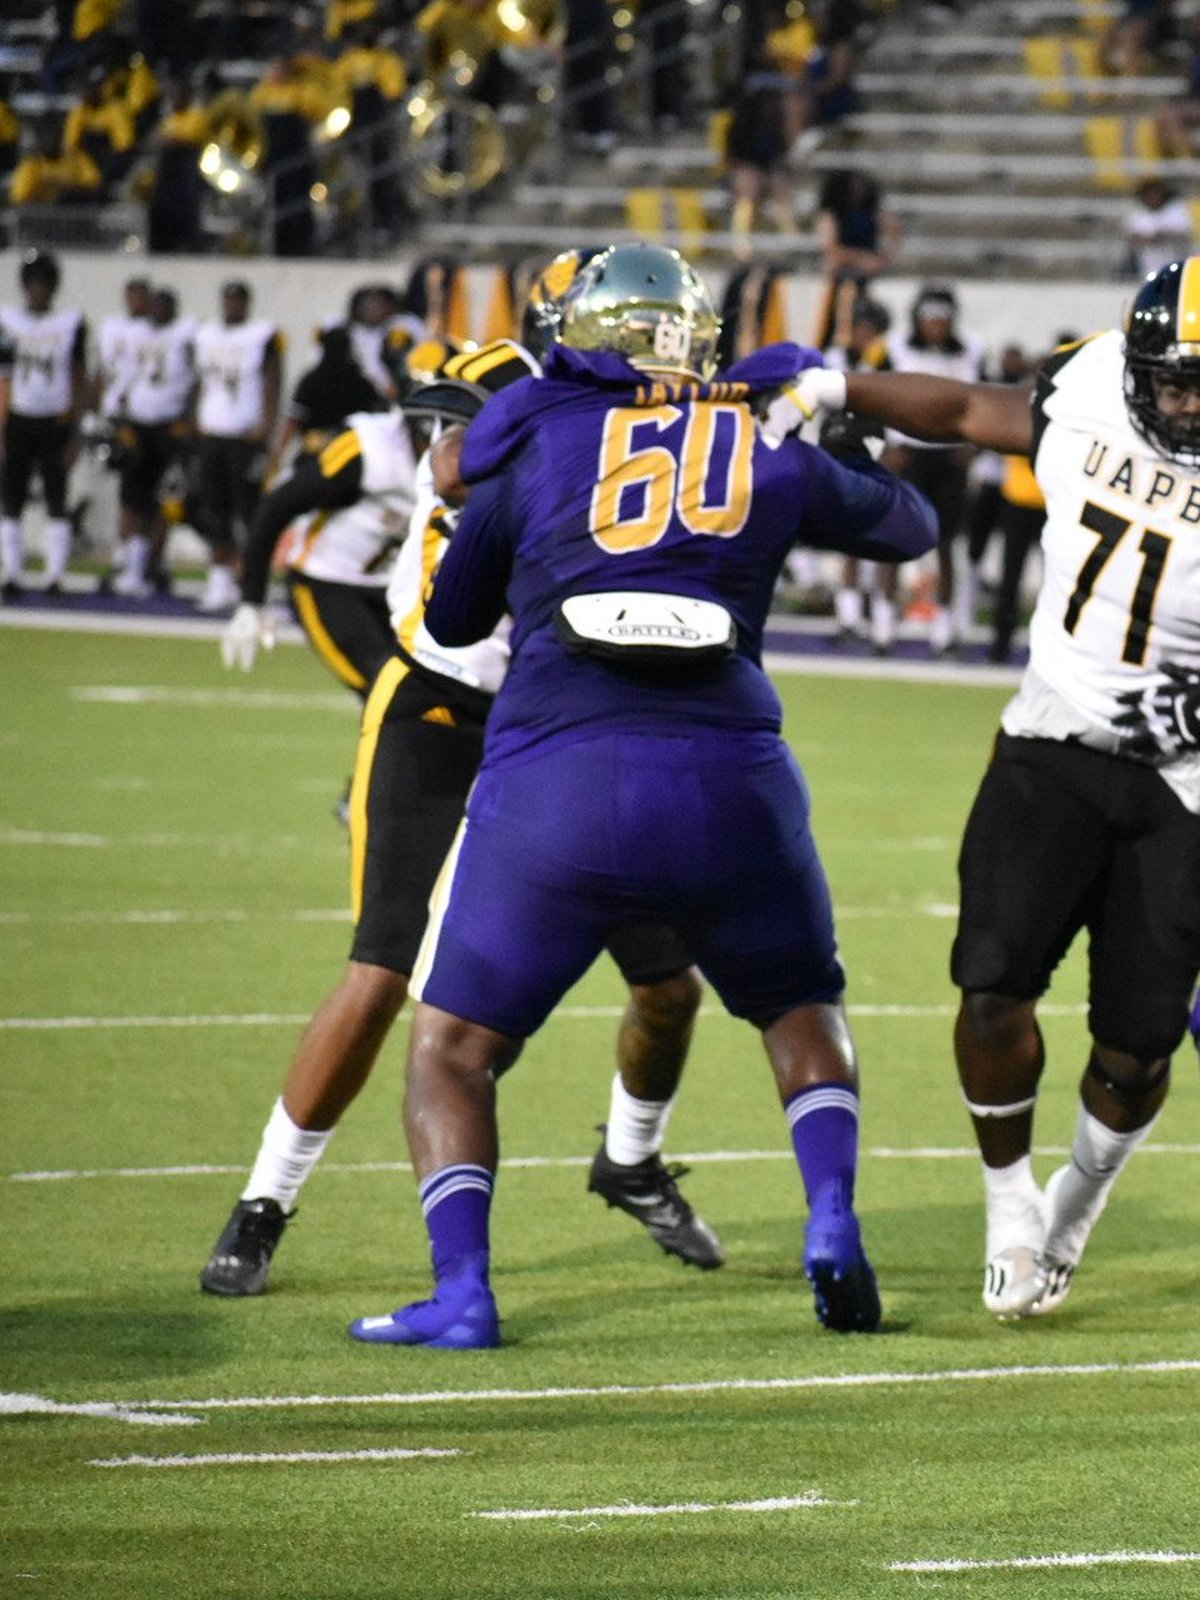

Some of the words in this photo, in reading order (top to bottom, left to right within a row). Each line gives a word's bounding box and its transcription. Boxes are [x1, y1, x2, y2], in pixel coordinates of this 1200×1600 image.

[654, 322, 692, 361] 60
[590, 401, 754, 554] 60
[1064, 500, 1175, 667] 71
[616, 624, 695, 641] BATTLE
